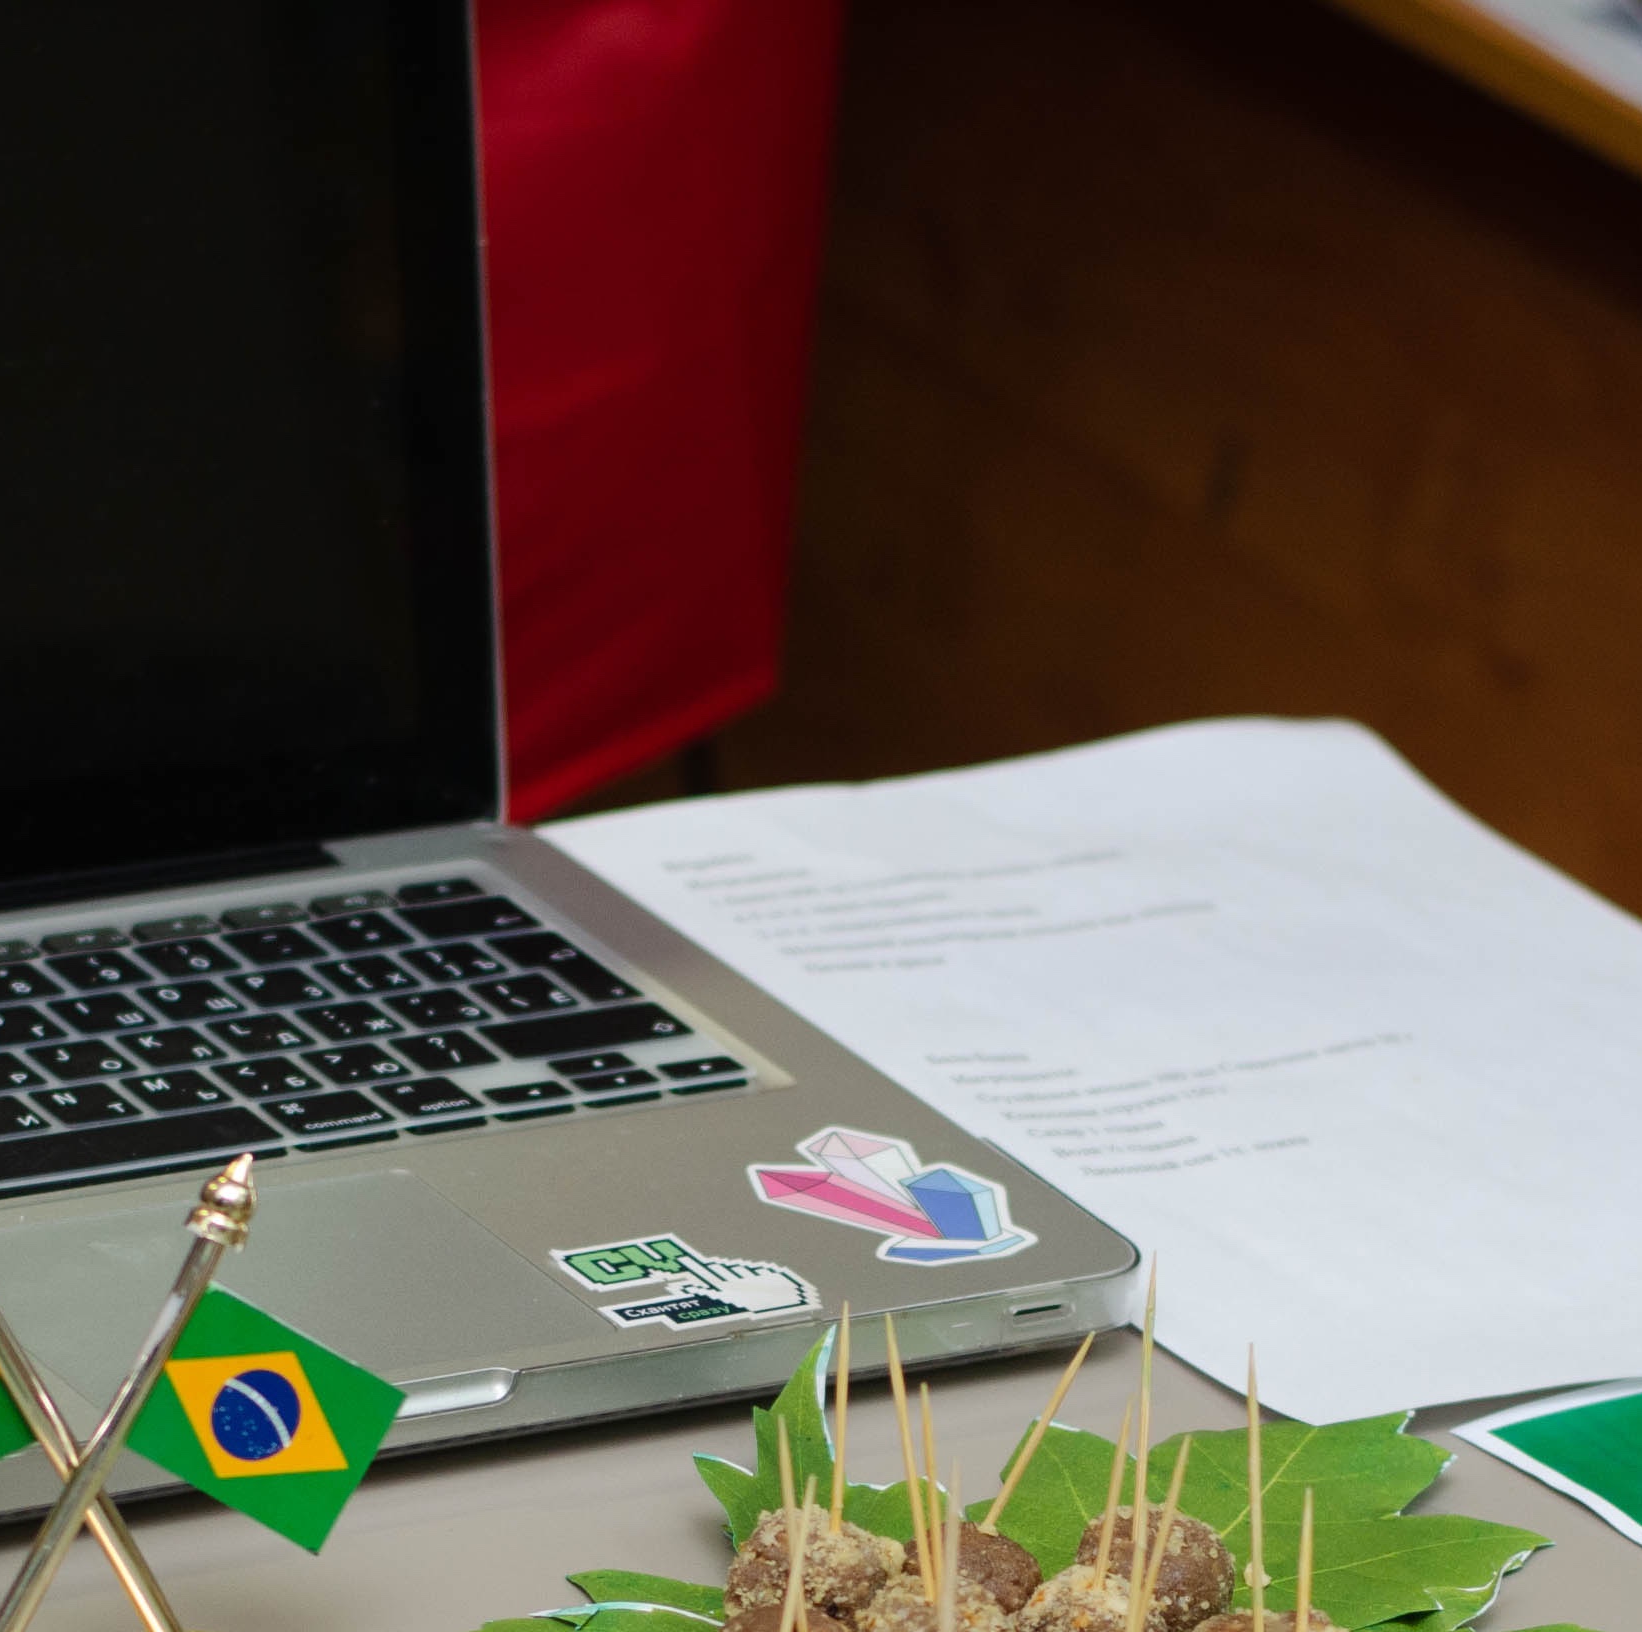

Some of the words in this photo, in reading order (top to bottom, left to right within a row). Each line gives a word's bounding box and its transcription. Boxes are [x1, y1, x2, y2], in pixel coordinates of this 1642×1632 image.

[101, 969, 120, 979] 9
[12, 982, 31, 992] 8
[247, 977, 264, 987] P
[230, 1025, 250, 1035] L
[139, 1036, 162, 1047] K
[57, 1050, 69, 1061] J
[142, 1078, 170, 1091] M
[52, 1093, 77, 1105] N
[421, 1100, 470, 1111] option
[17, 1114, 39, 1126] И
[303, 1111, 384, 1131] command
[624, 1299, 700, 1319] Схантят
[677, 1304, 731, 1321] сразу
